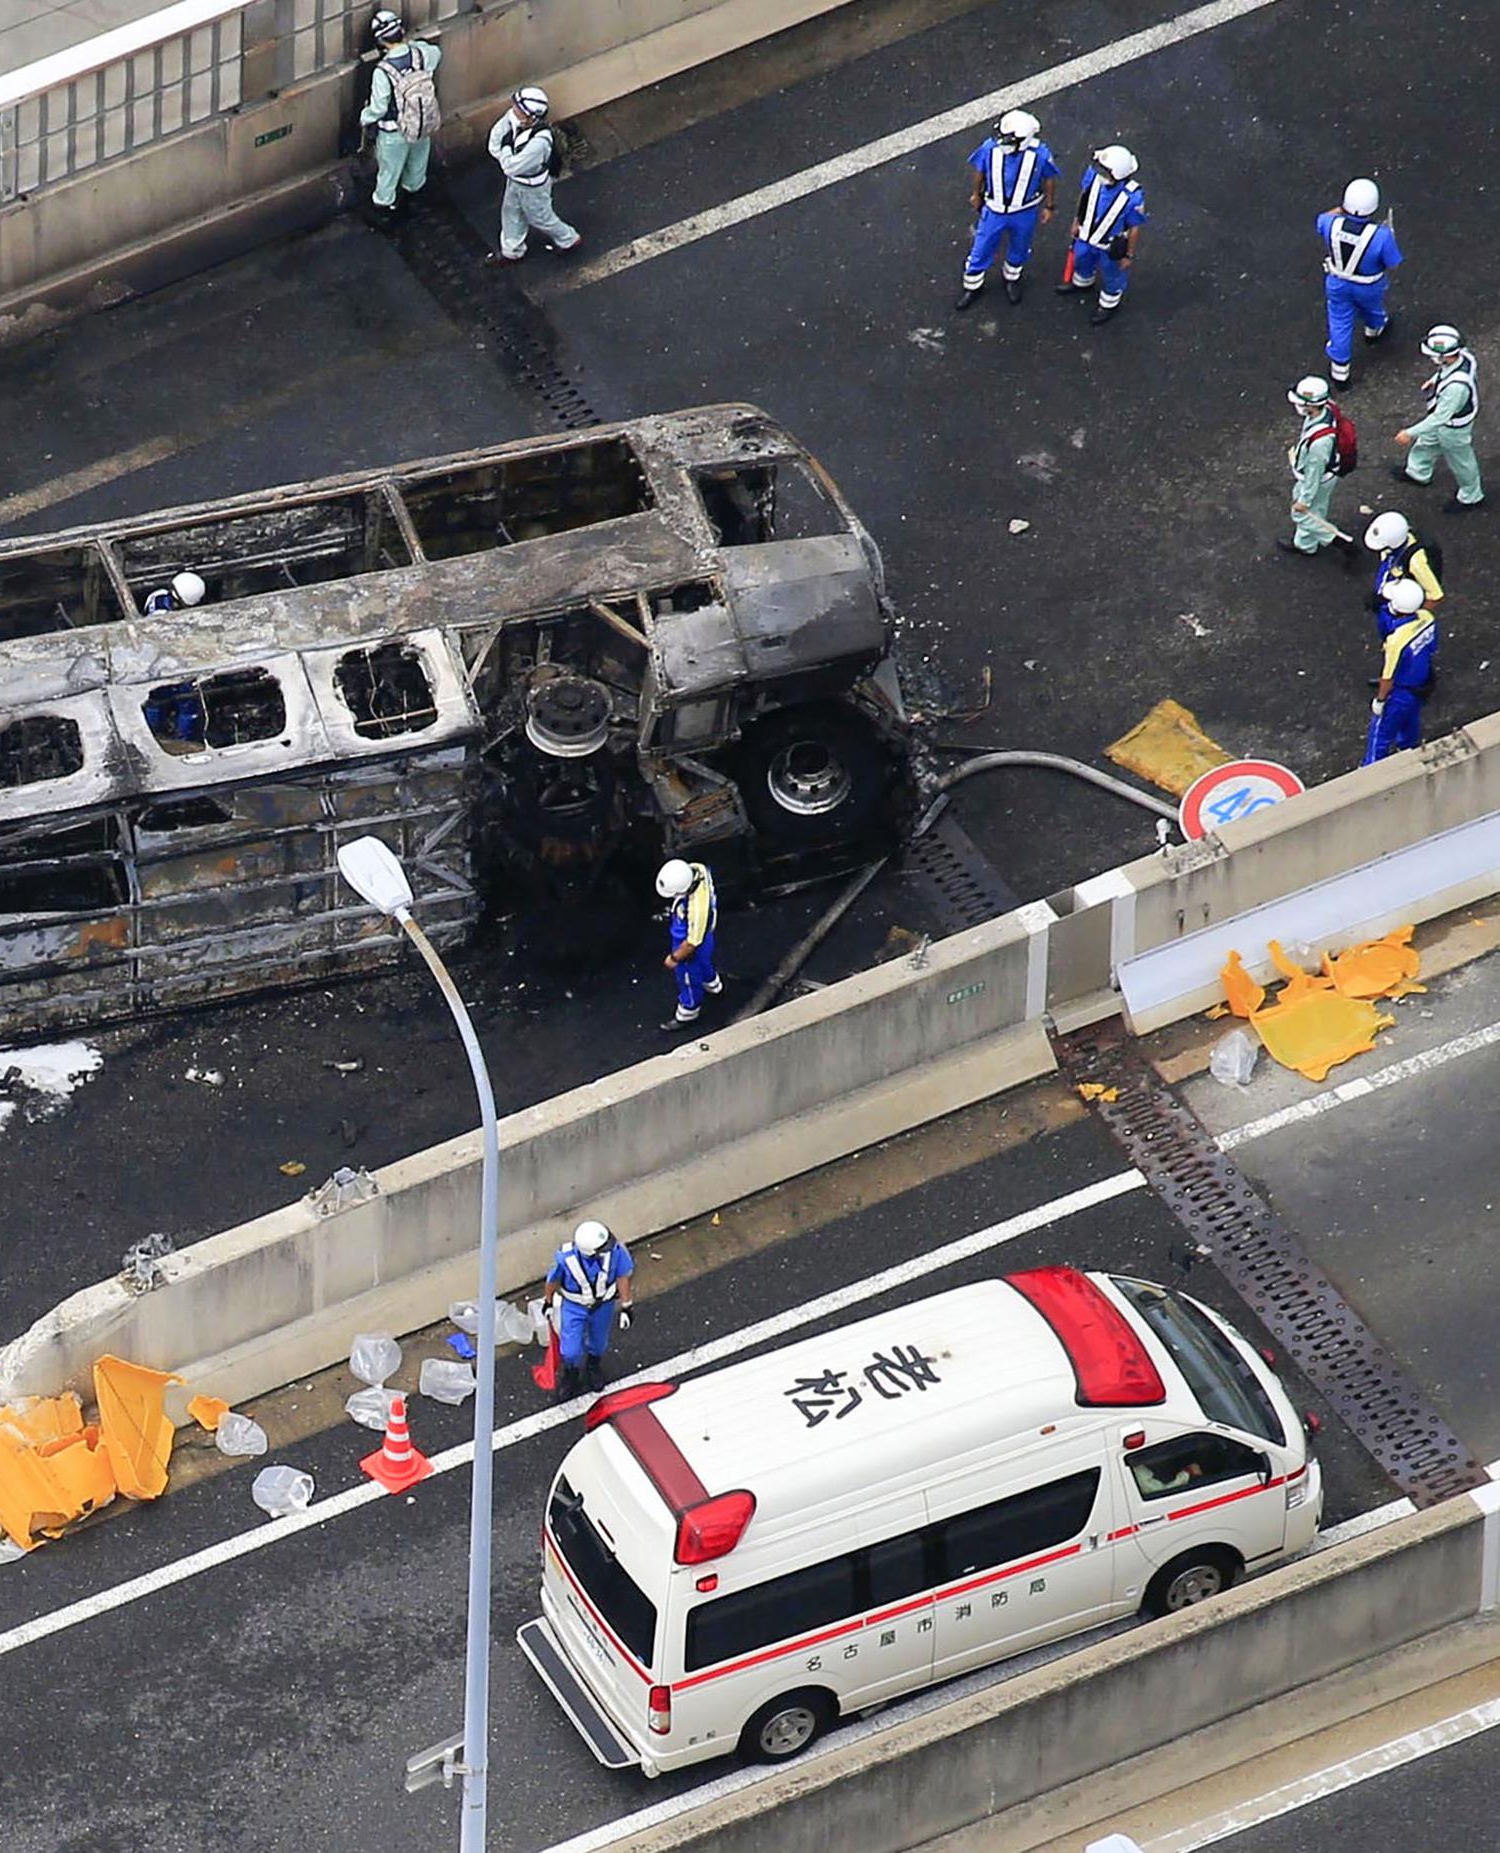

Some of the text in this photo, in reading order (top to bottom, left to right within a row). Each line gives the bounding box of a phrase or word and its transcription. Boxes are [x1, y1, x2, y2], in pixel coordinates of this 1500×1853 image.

[783, 1344, 942, 1428] 老松
[806, 1578, 1046, 1671] 名古屋市消防局
